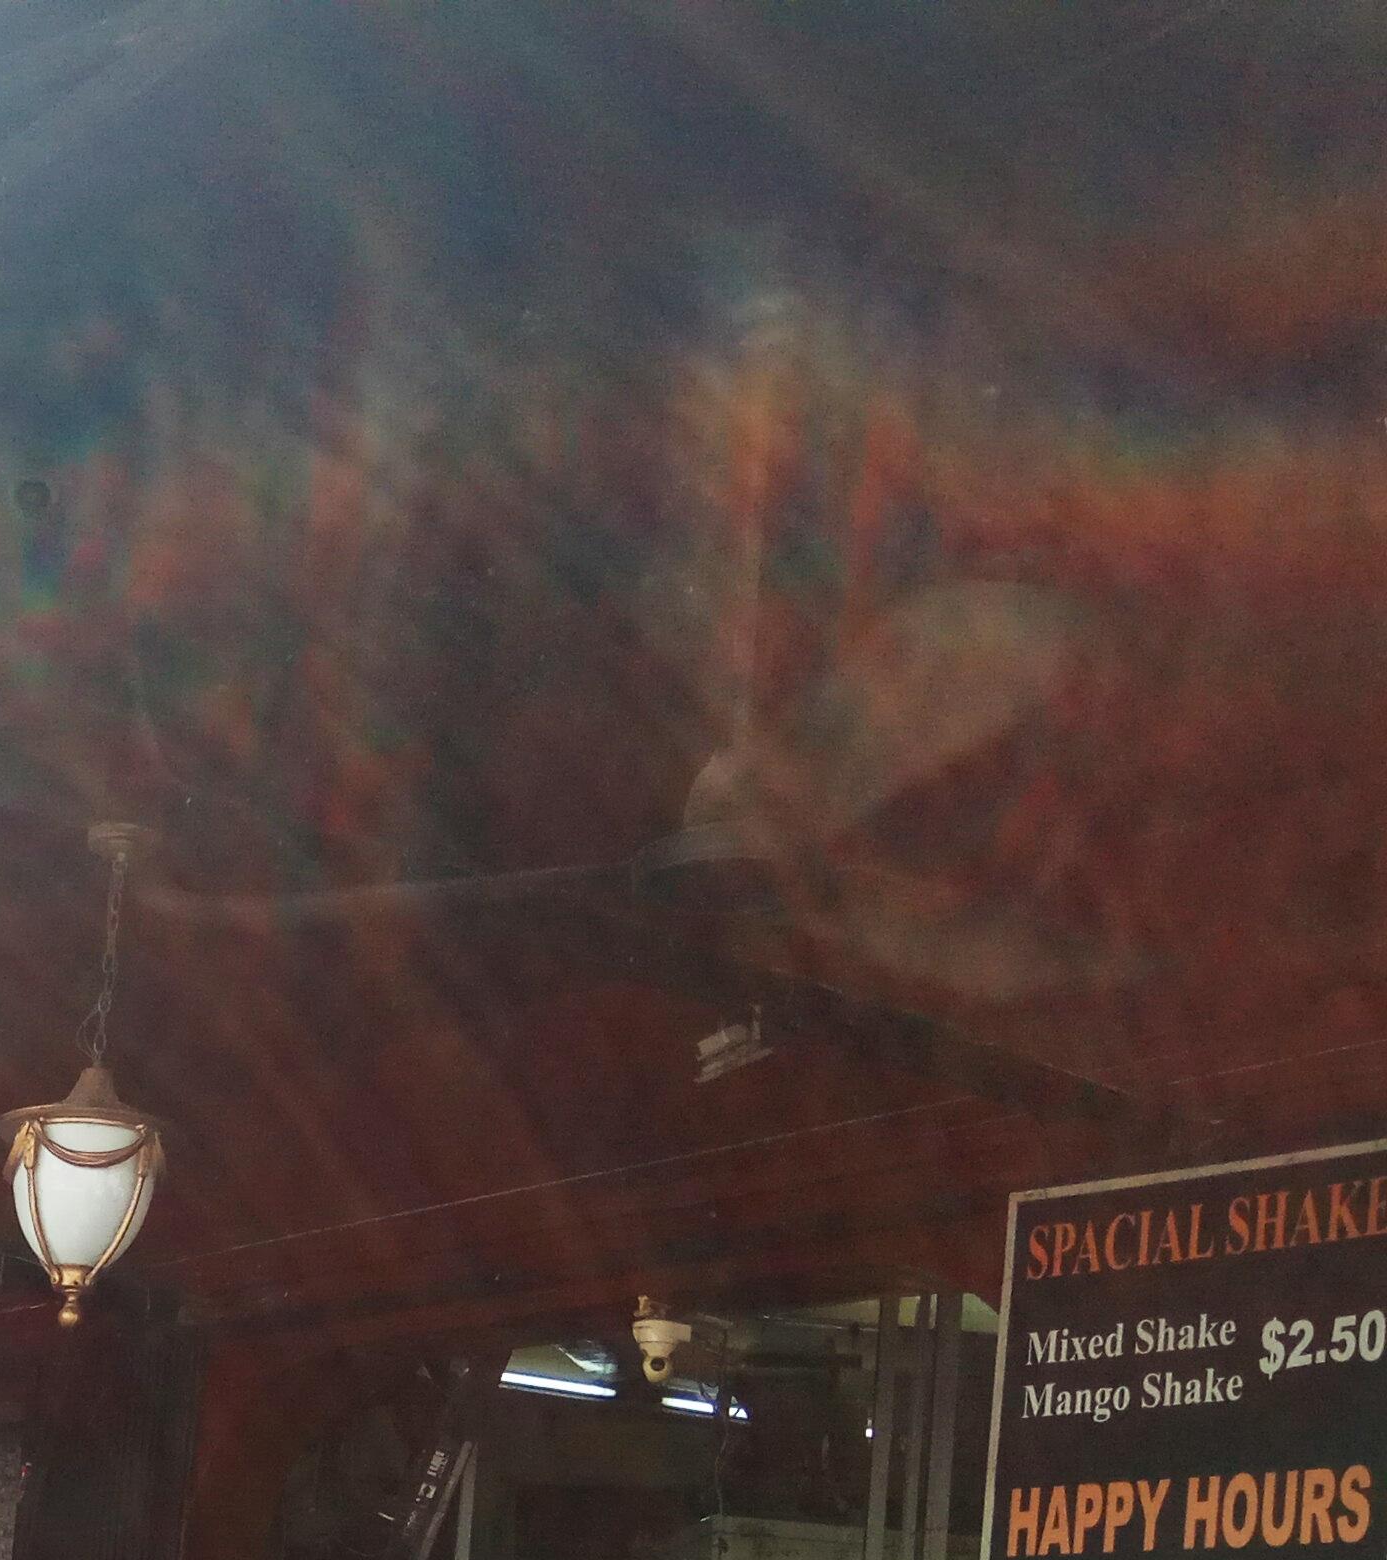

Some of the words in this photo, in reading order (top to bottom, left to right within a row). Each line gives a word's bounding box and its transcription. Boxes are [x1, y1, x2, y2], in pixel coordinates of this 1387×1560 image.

[1028, 1203, 1215, 1281] SPACIAL
[1026, 1323, 1124, 1366] Mixed
[1135, 1313, 1237, 1355] Shake
[1259, 1309, 1387, 1380] $2.50
[1021, 1382, 1131, 1422] Mango
[1141, 1368, 1244, 1408] Shake
[1007, 1478, 1171, 1558] HAPPY
[1183, 1464, 1372, 1550] HOURS
